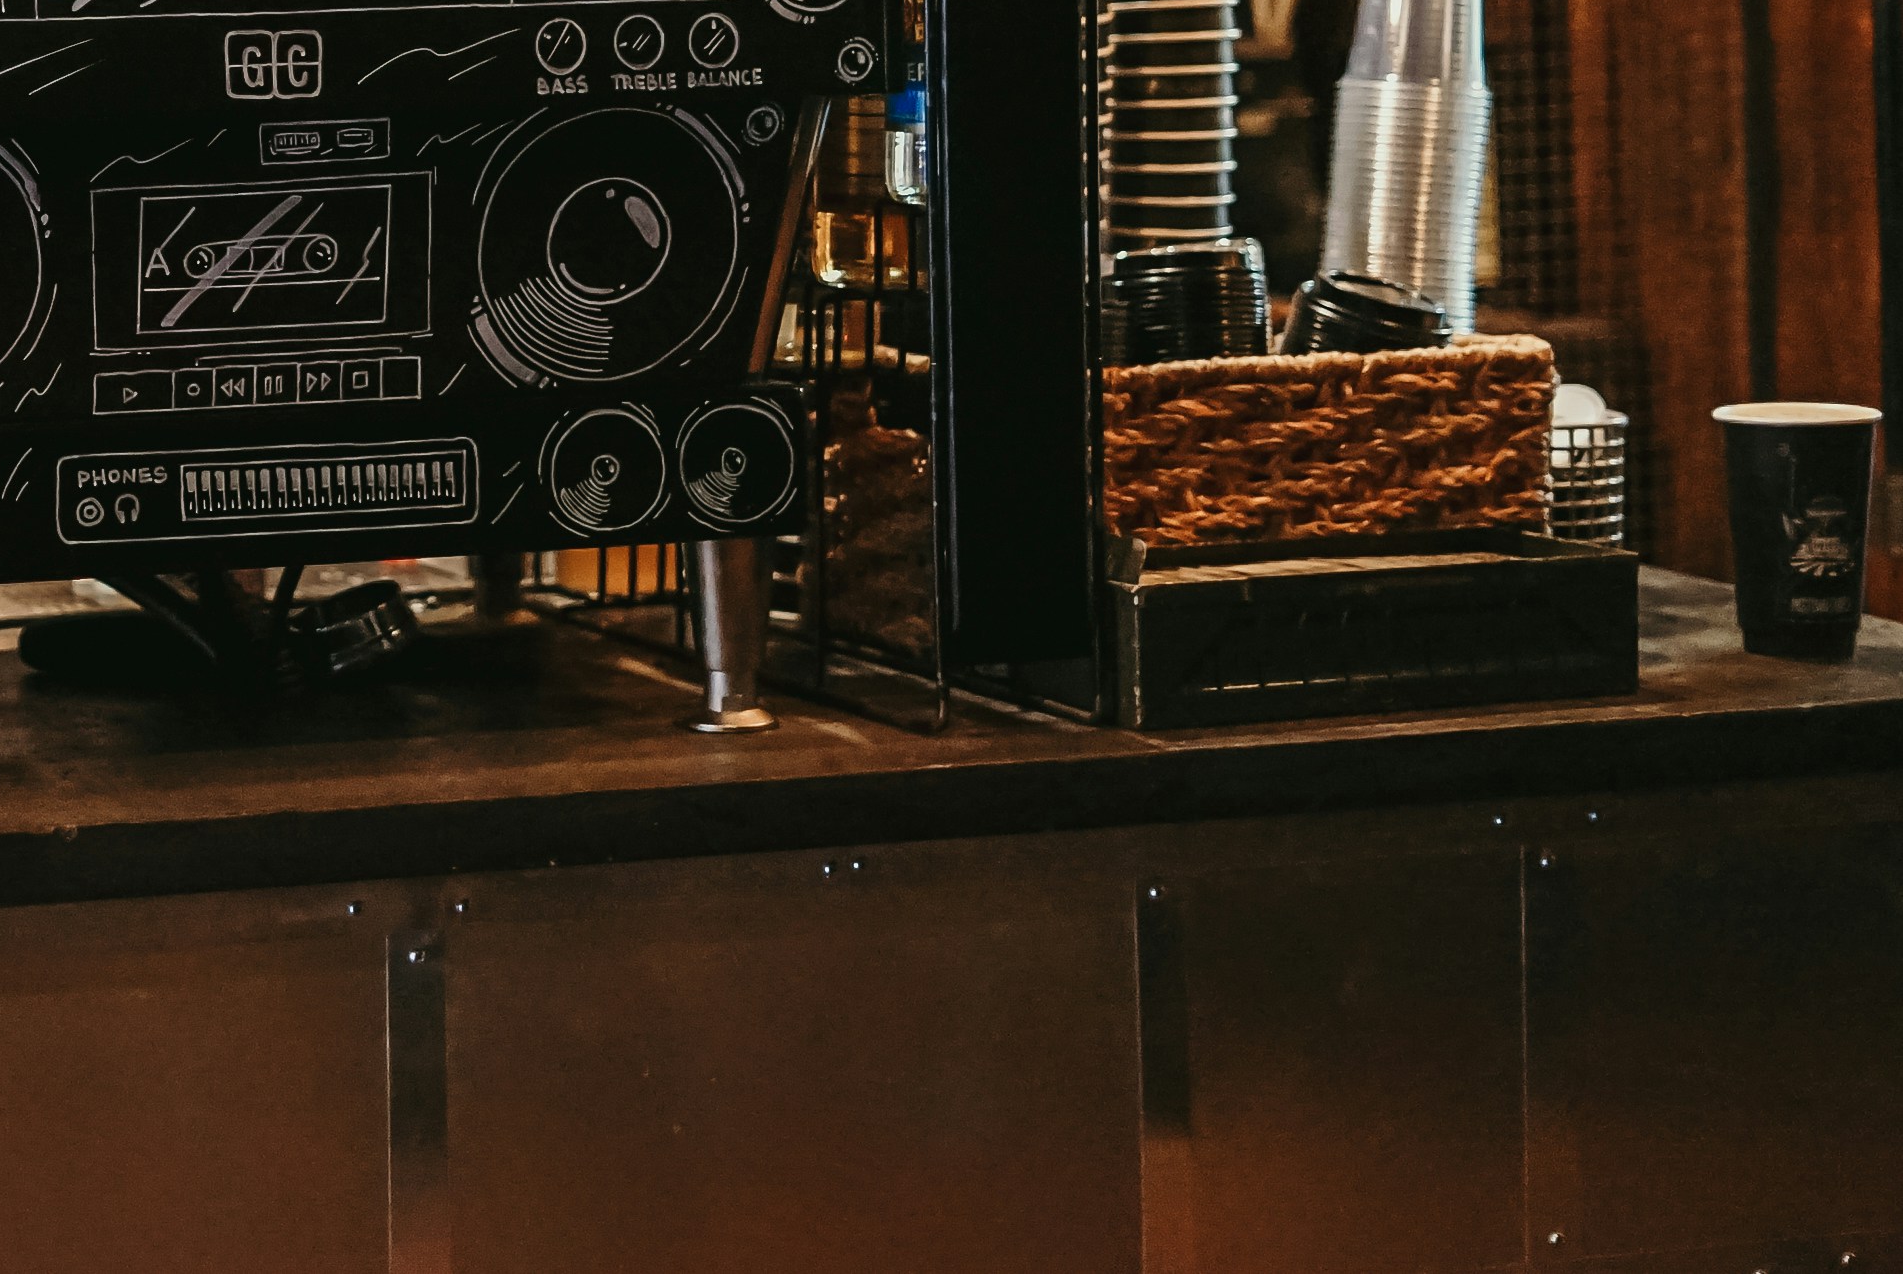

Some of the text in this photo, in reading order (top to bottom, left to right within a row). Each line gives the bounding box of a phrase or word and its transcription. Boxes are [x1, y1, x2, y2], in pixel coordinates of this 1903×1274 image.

[536, 67, 763, 95] BASS TREBLE BALANCE
[146, 248, 170, 277] A
[77, 466, 168, 486] PHONES
